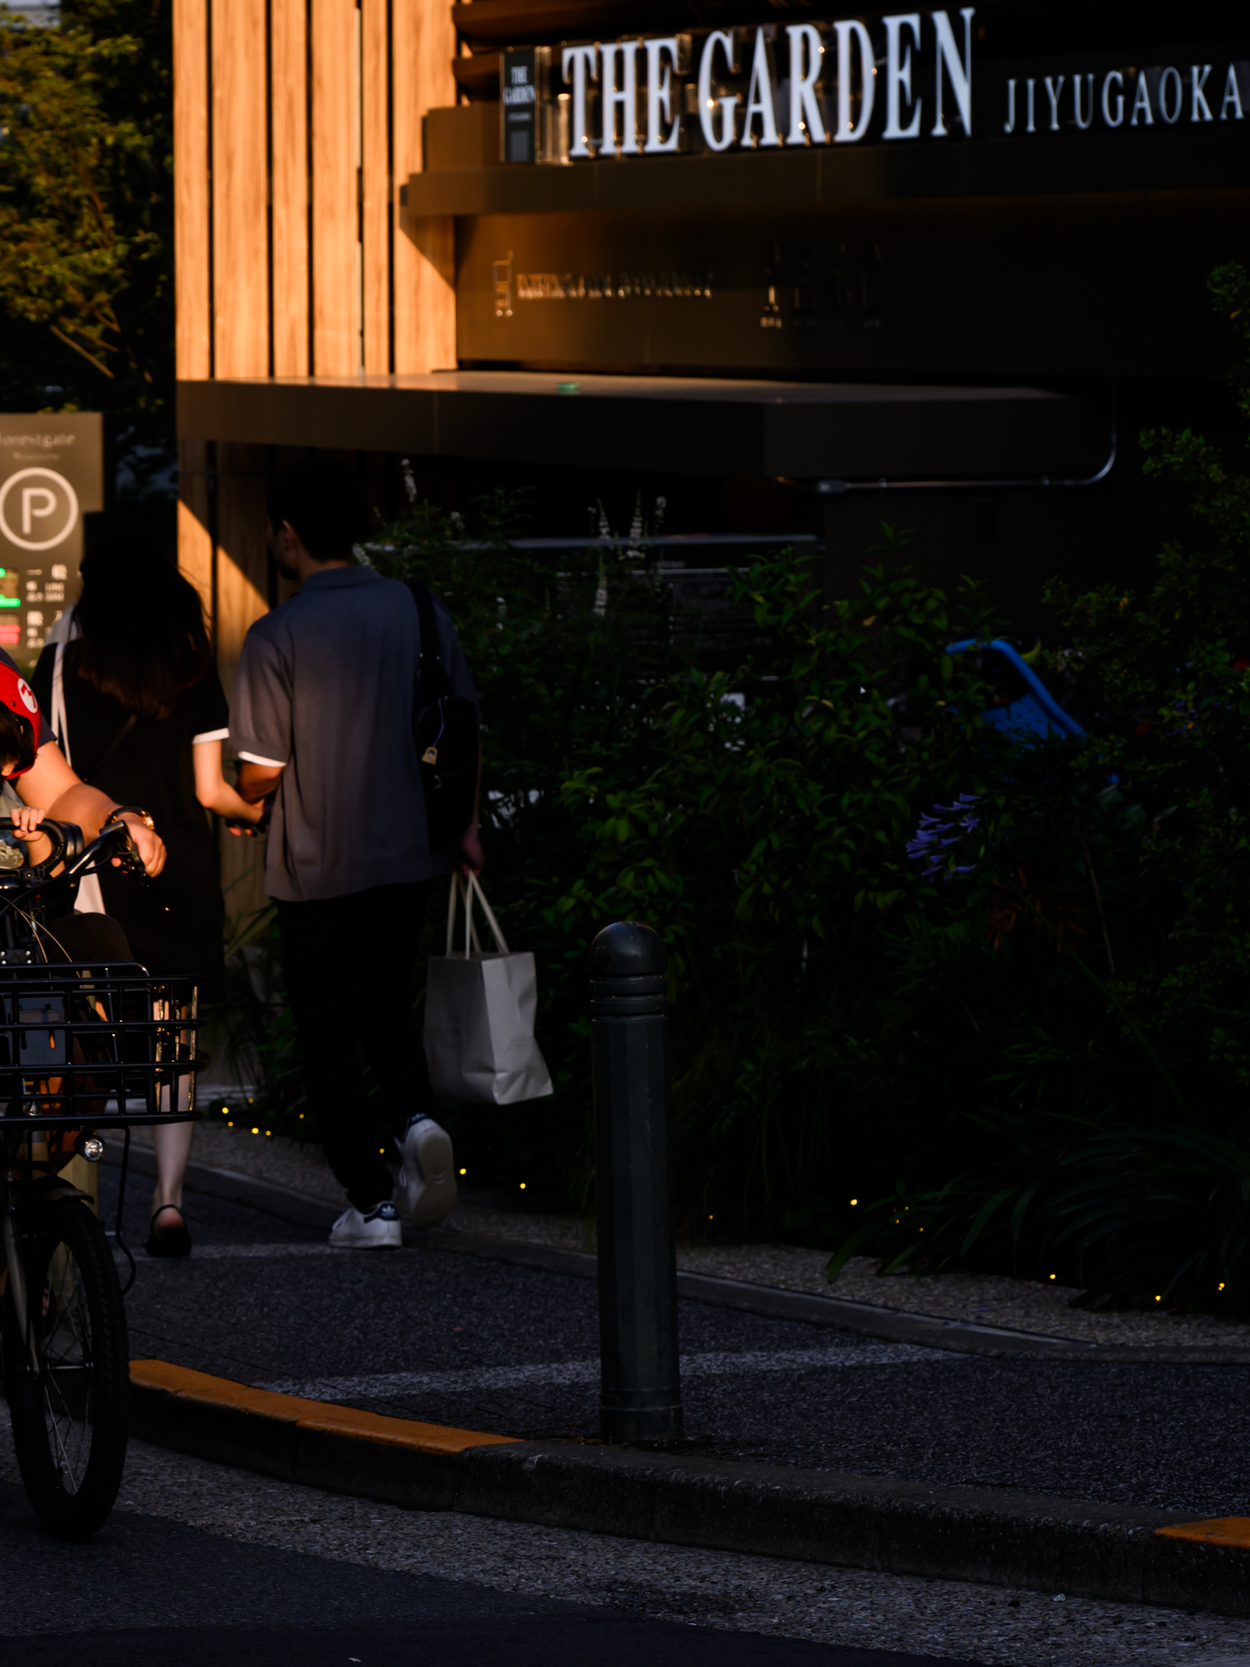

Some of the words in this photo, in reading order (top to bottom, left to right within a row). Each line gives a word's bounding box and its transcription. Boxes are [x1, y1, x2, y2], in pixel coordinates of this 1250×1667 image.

[502, 84, 536, 106] GARDEN
[510, 65, 529, 86] THE
[561, 36, 683, 158] THE
[698, 7, 977, 153] GARDEN
[1003, 61, 1246, 135] JIYUGAOKA
[22, 487, 58, 535] P
